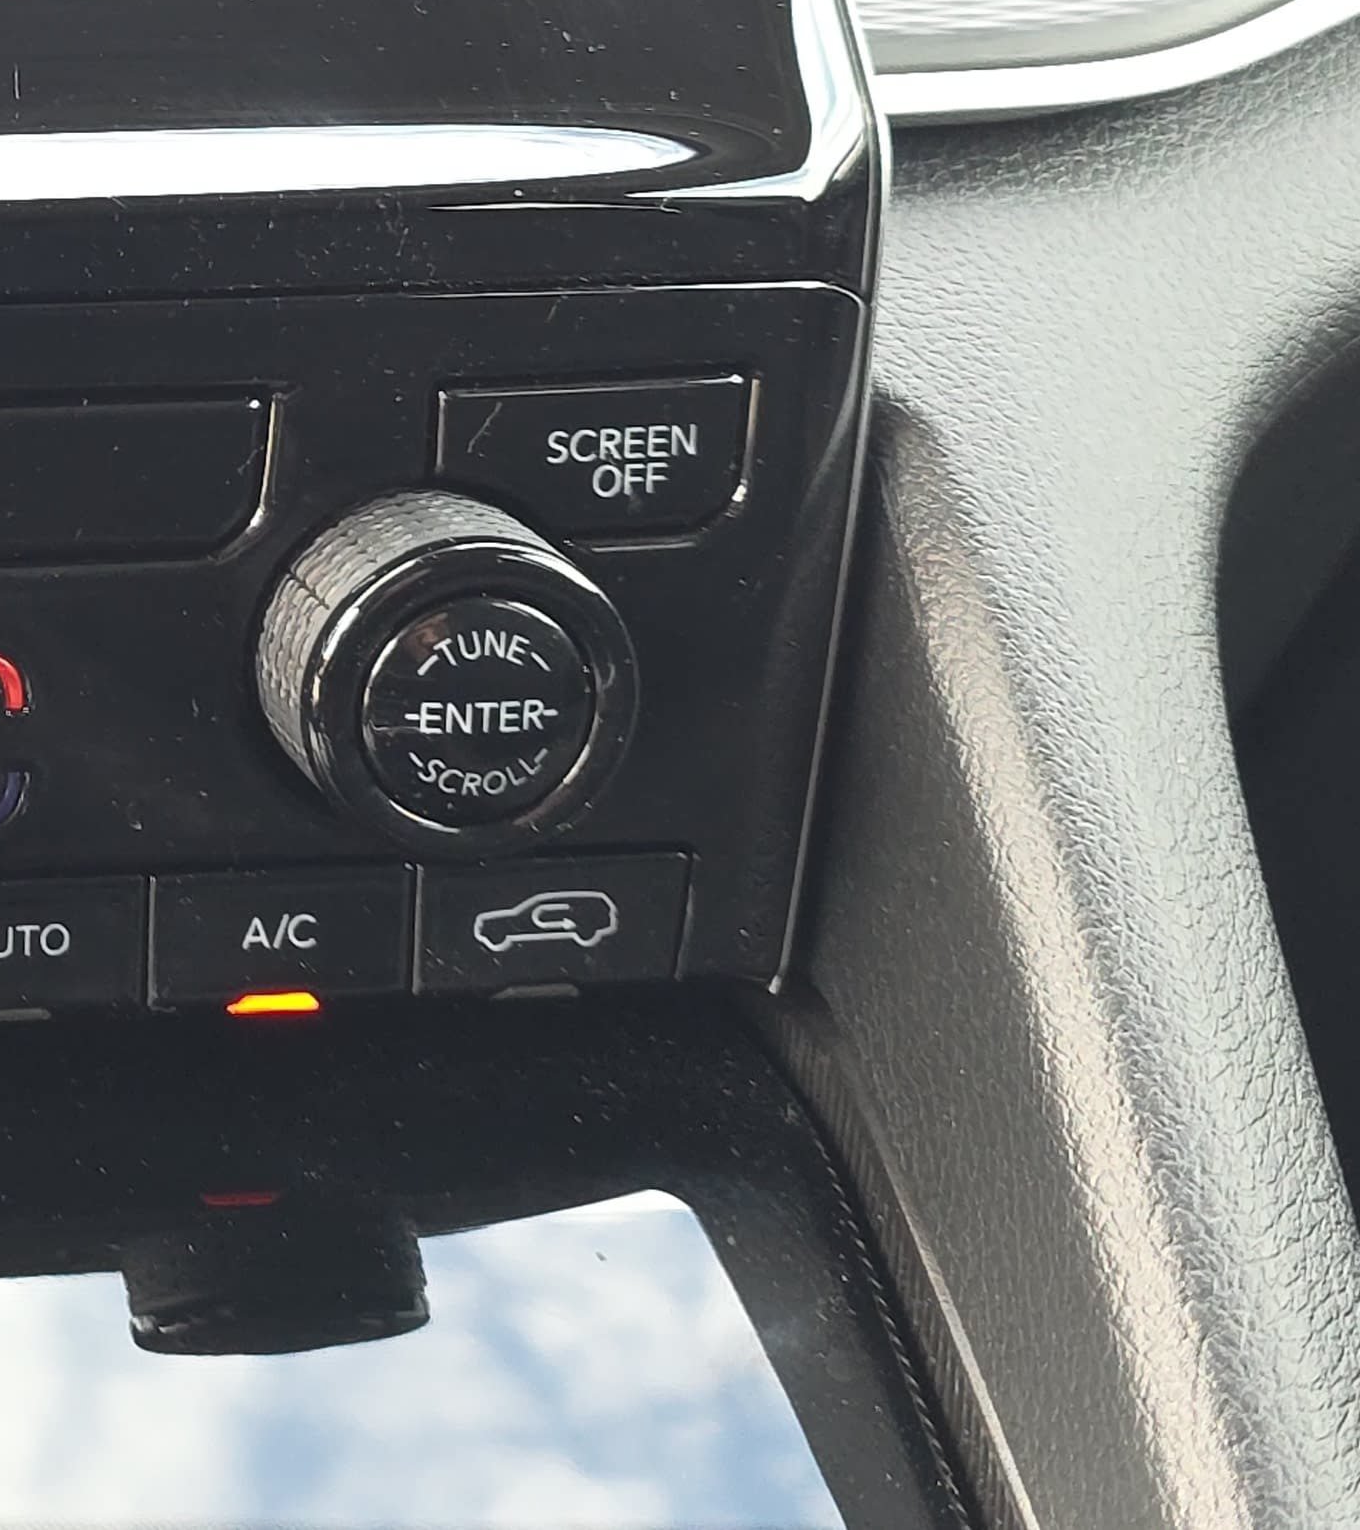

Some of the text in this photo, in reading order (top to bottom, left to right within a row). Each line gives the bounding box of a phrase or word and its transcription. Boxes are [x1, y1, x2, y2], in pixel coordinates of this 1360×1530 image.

[546, 423, 698, 465] SCREEN
[592, 462, 668, 498] OFF
[434, 629, 530, 667] TUNE
[419, 753, 542, 797] SCROLL
[241, 913, 319, 952] A/C
